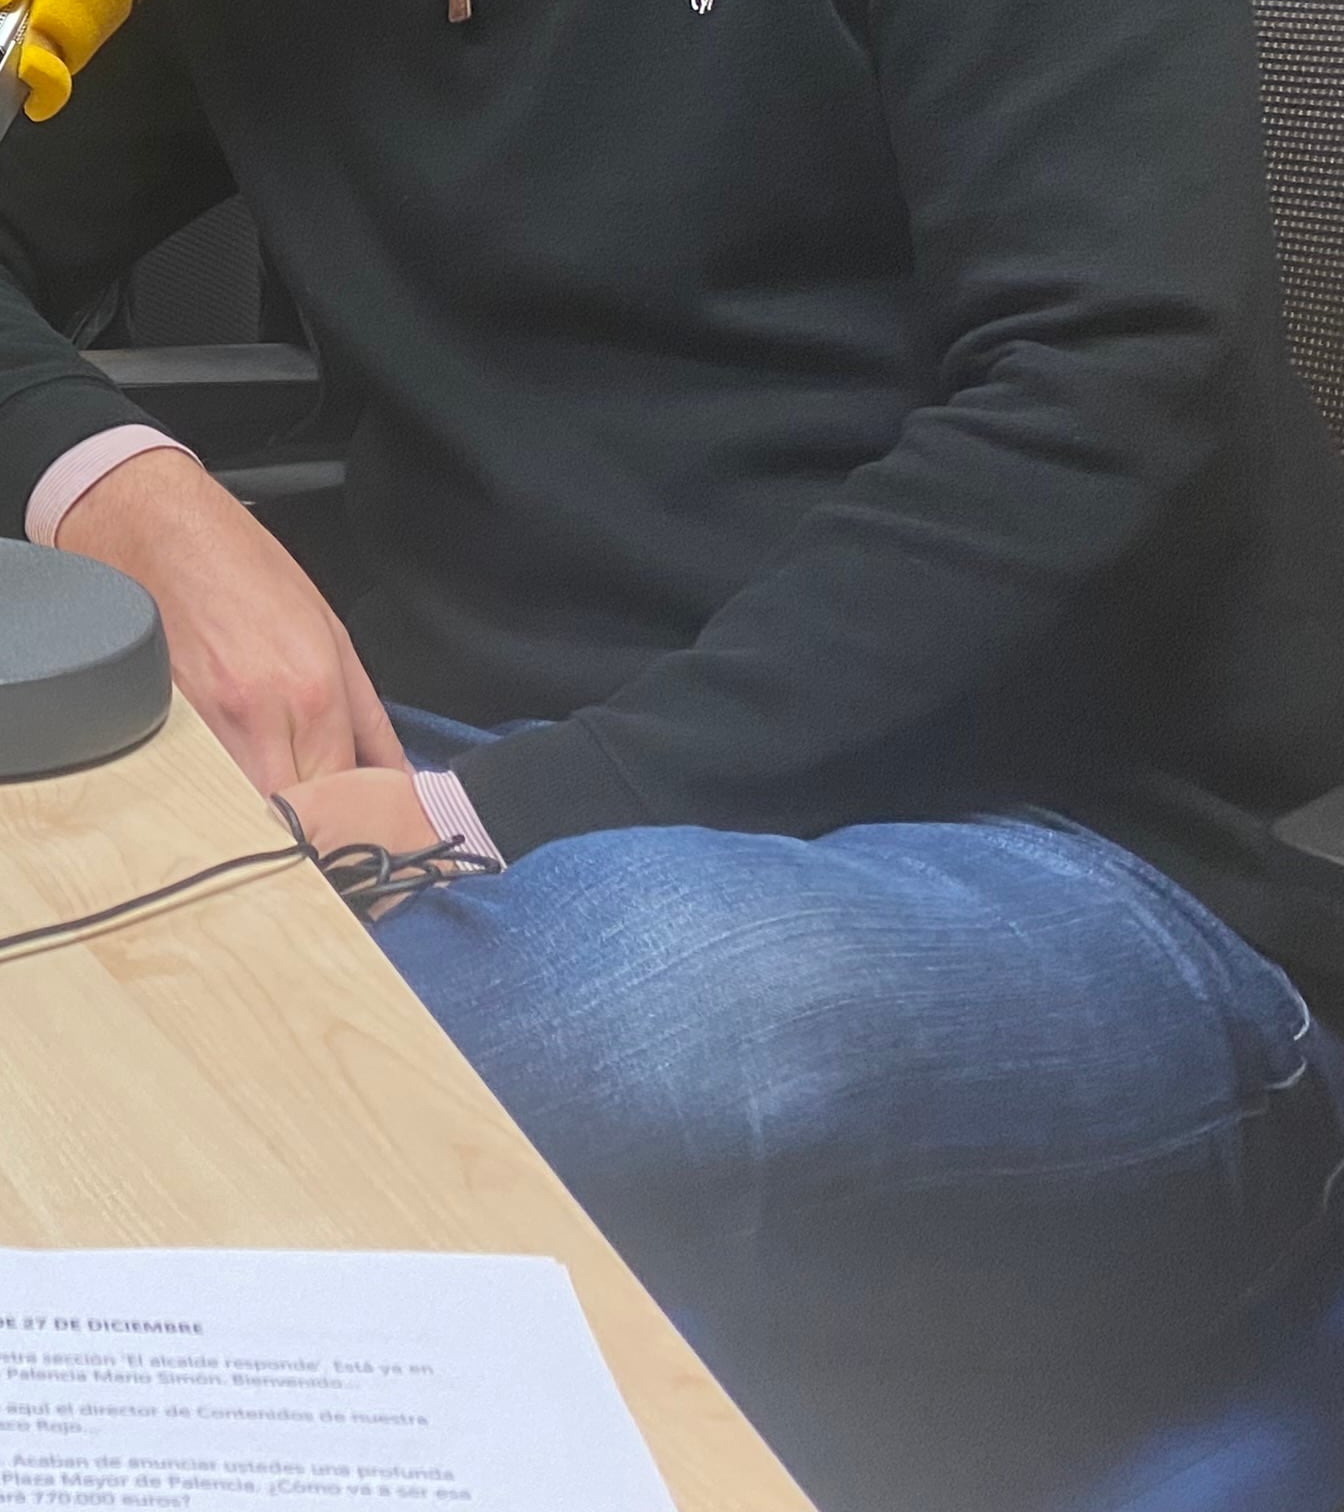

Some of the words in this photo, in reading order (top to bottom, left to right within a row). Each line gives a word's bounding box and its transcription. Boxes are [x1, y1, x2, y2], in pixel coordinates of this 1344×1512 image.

[54, 1317, 81, 1331] DE
[88, 1319, 203, 1335] DICIEMBRE
[7, 1367, 87, 1382] Palencia
